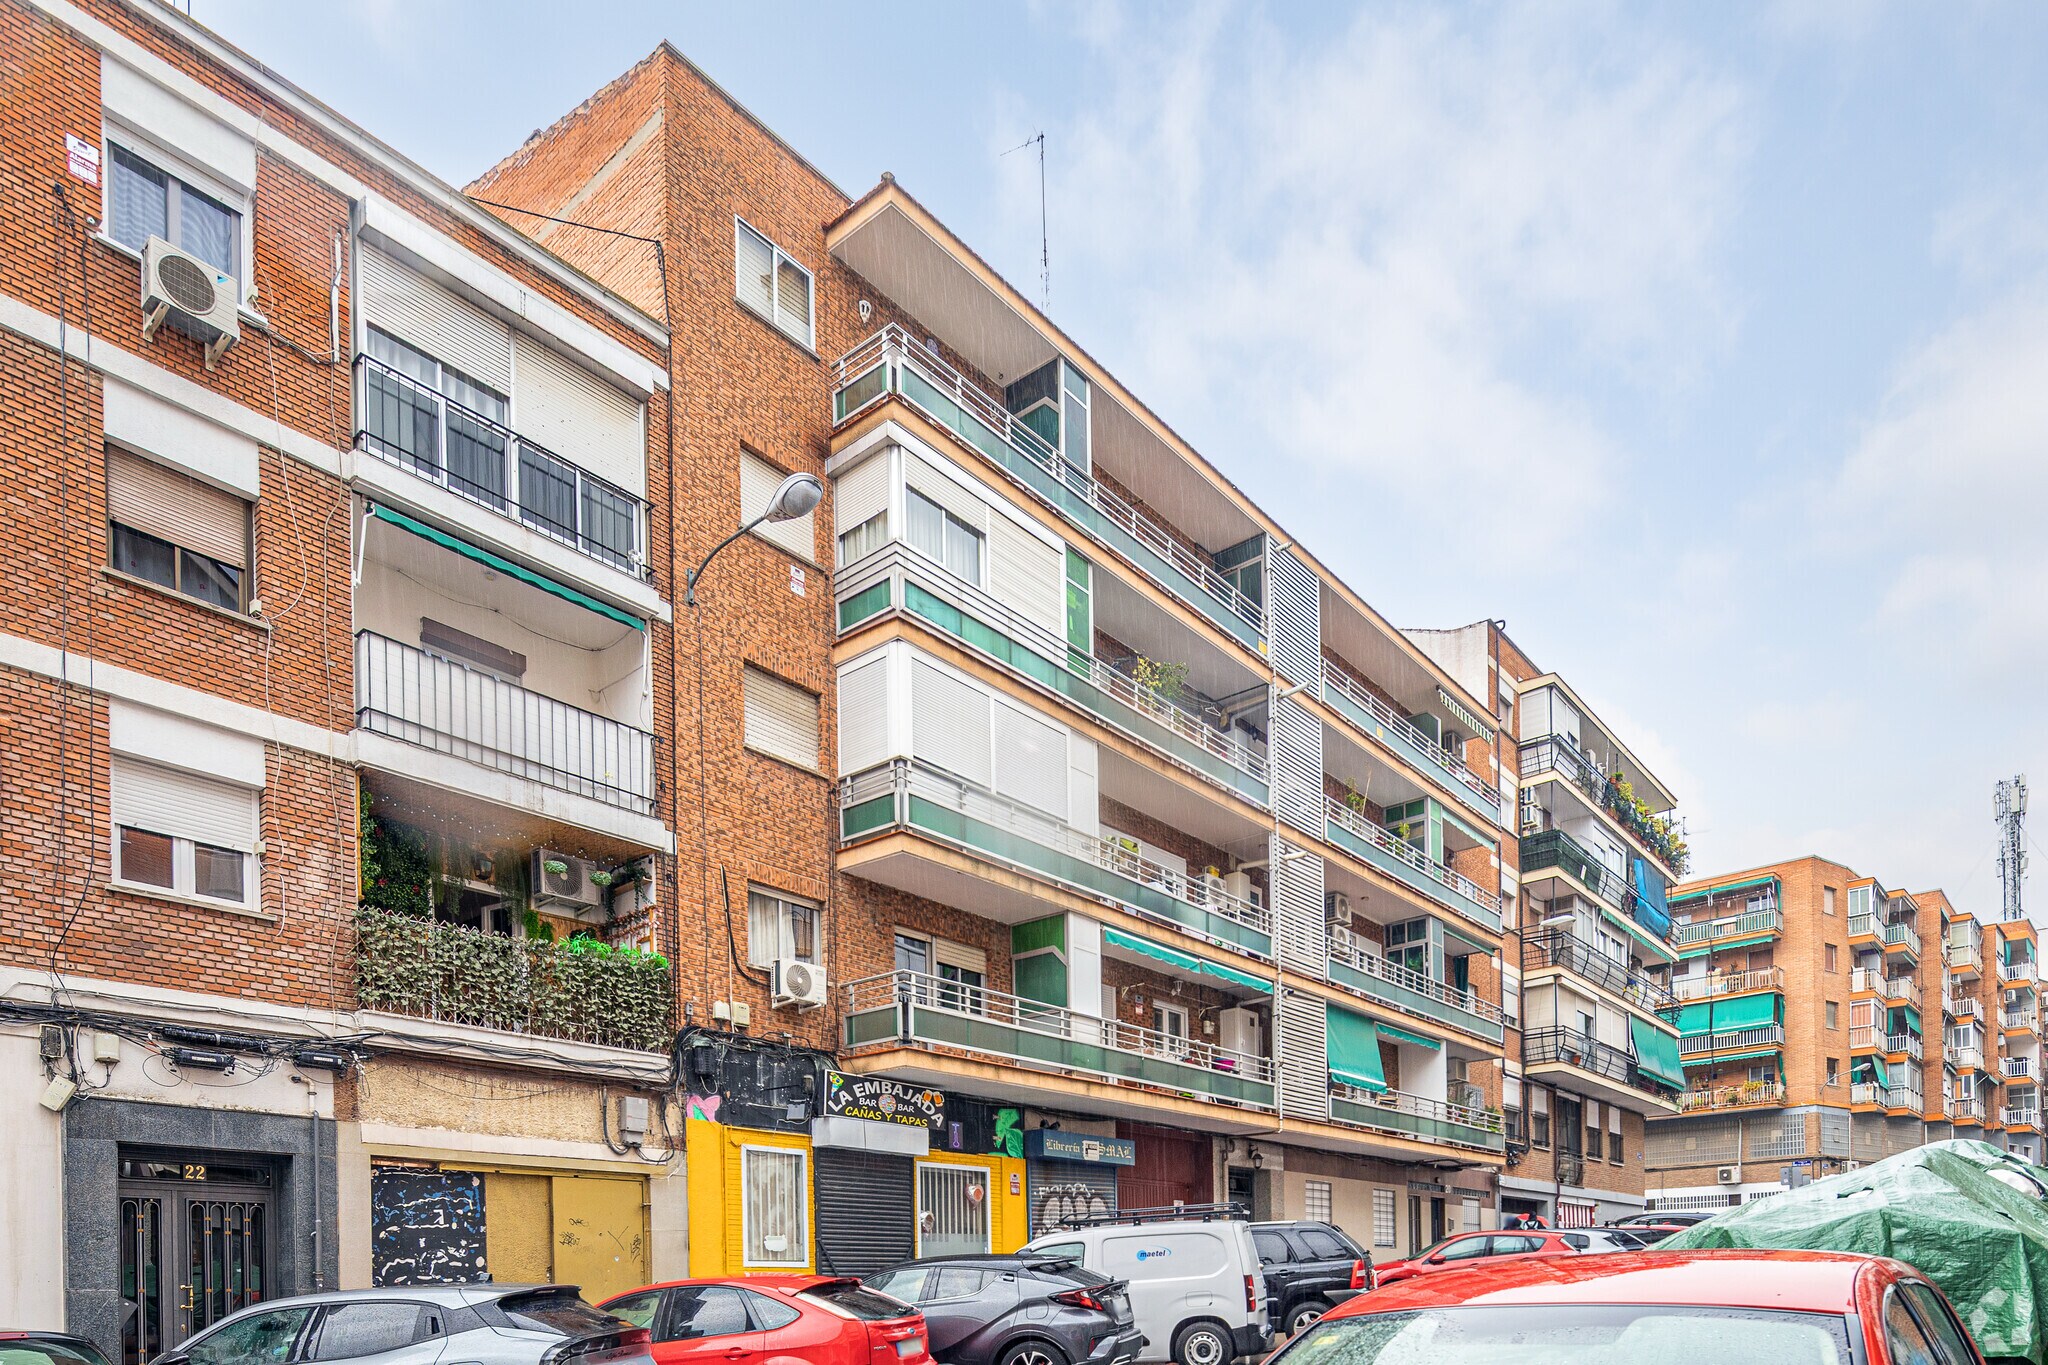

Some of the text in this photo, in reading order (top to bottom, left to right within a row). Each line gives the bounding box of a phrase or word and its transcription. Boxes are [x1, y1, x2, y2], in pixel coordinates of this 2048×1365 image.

[828, 1081, 944, 1127] LA EMBAJADA
[859, 1097, 915, 1113] BAR BAR
[845, 1106, 928, 1128] CAÑAS Y TAPAS
[1046, 1138, 1080, 1153] Librería
[185, 1164, 205, 1180] 22
[1140, 1249, 1166, 1257] maetel
